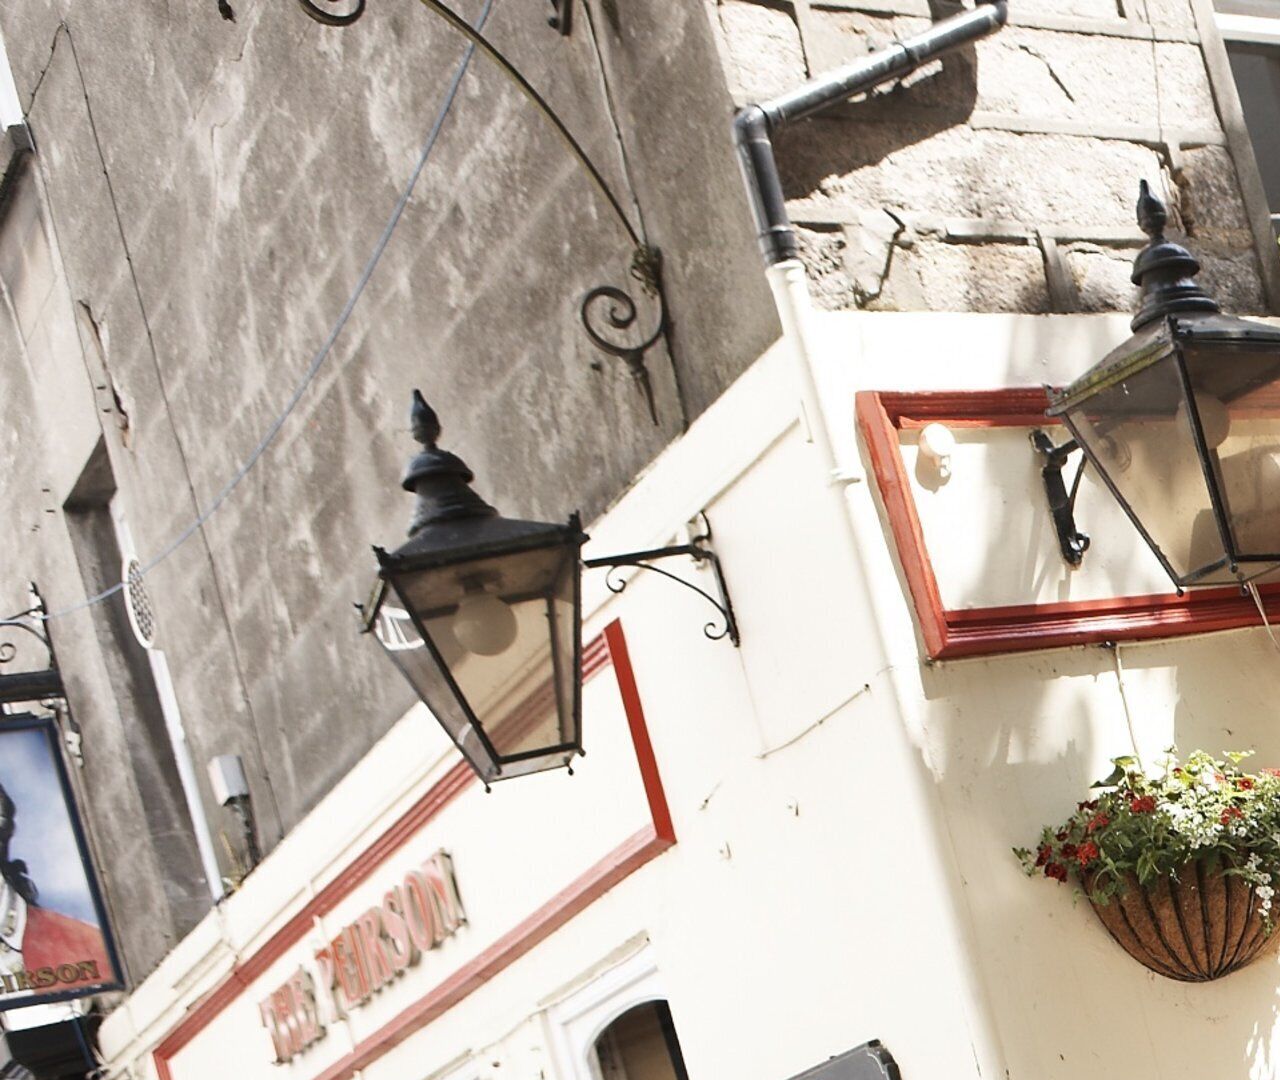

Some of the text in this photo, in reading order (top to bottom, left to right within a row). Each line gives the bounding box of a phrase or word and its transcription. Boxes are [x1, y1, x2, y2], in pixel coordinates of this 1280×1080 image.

[0, 959, 102, 995] IRSON
[258, 848, 470, 1067] THE PEIRSON
